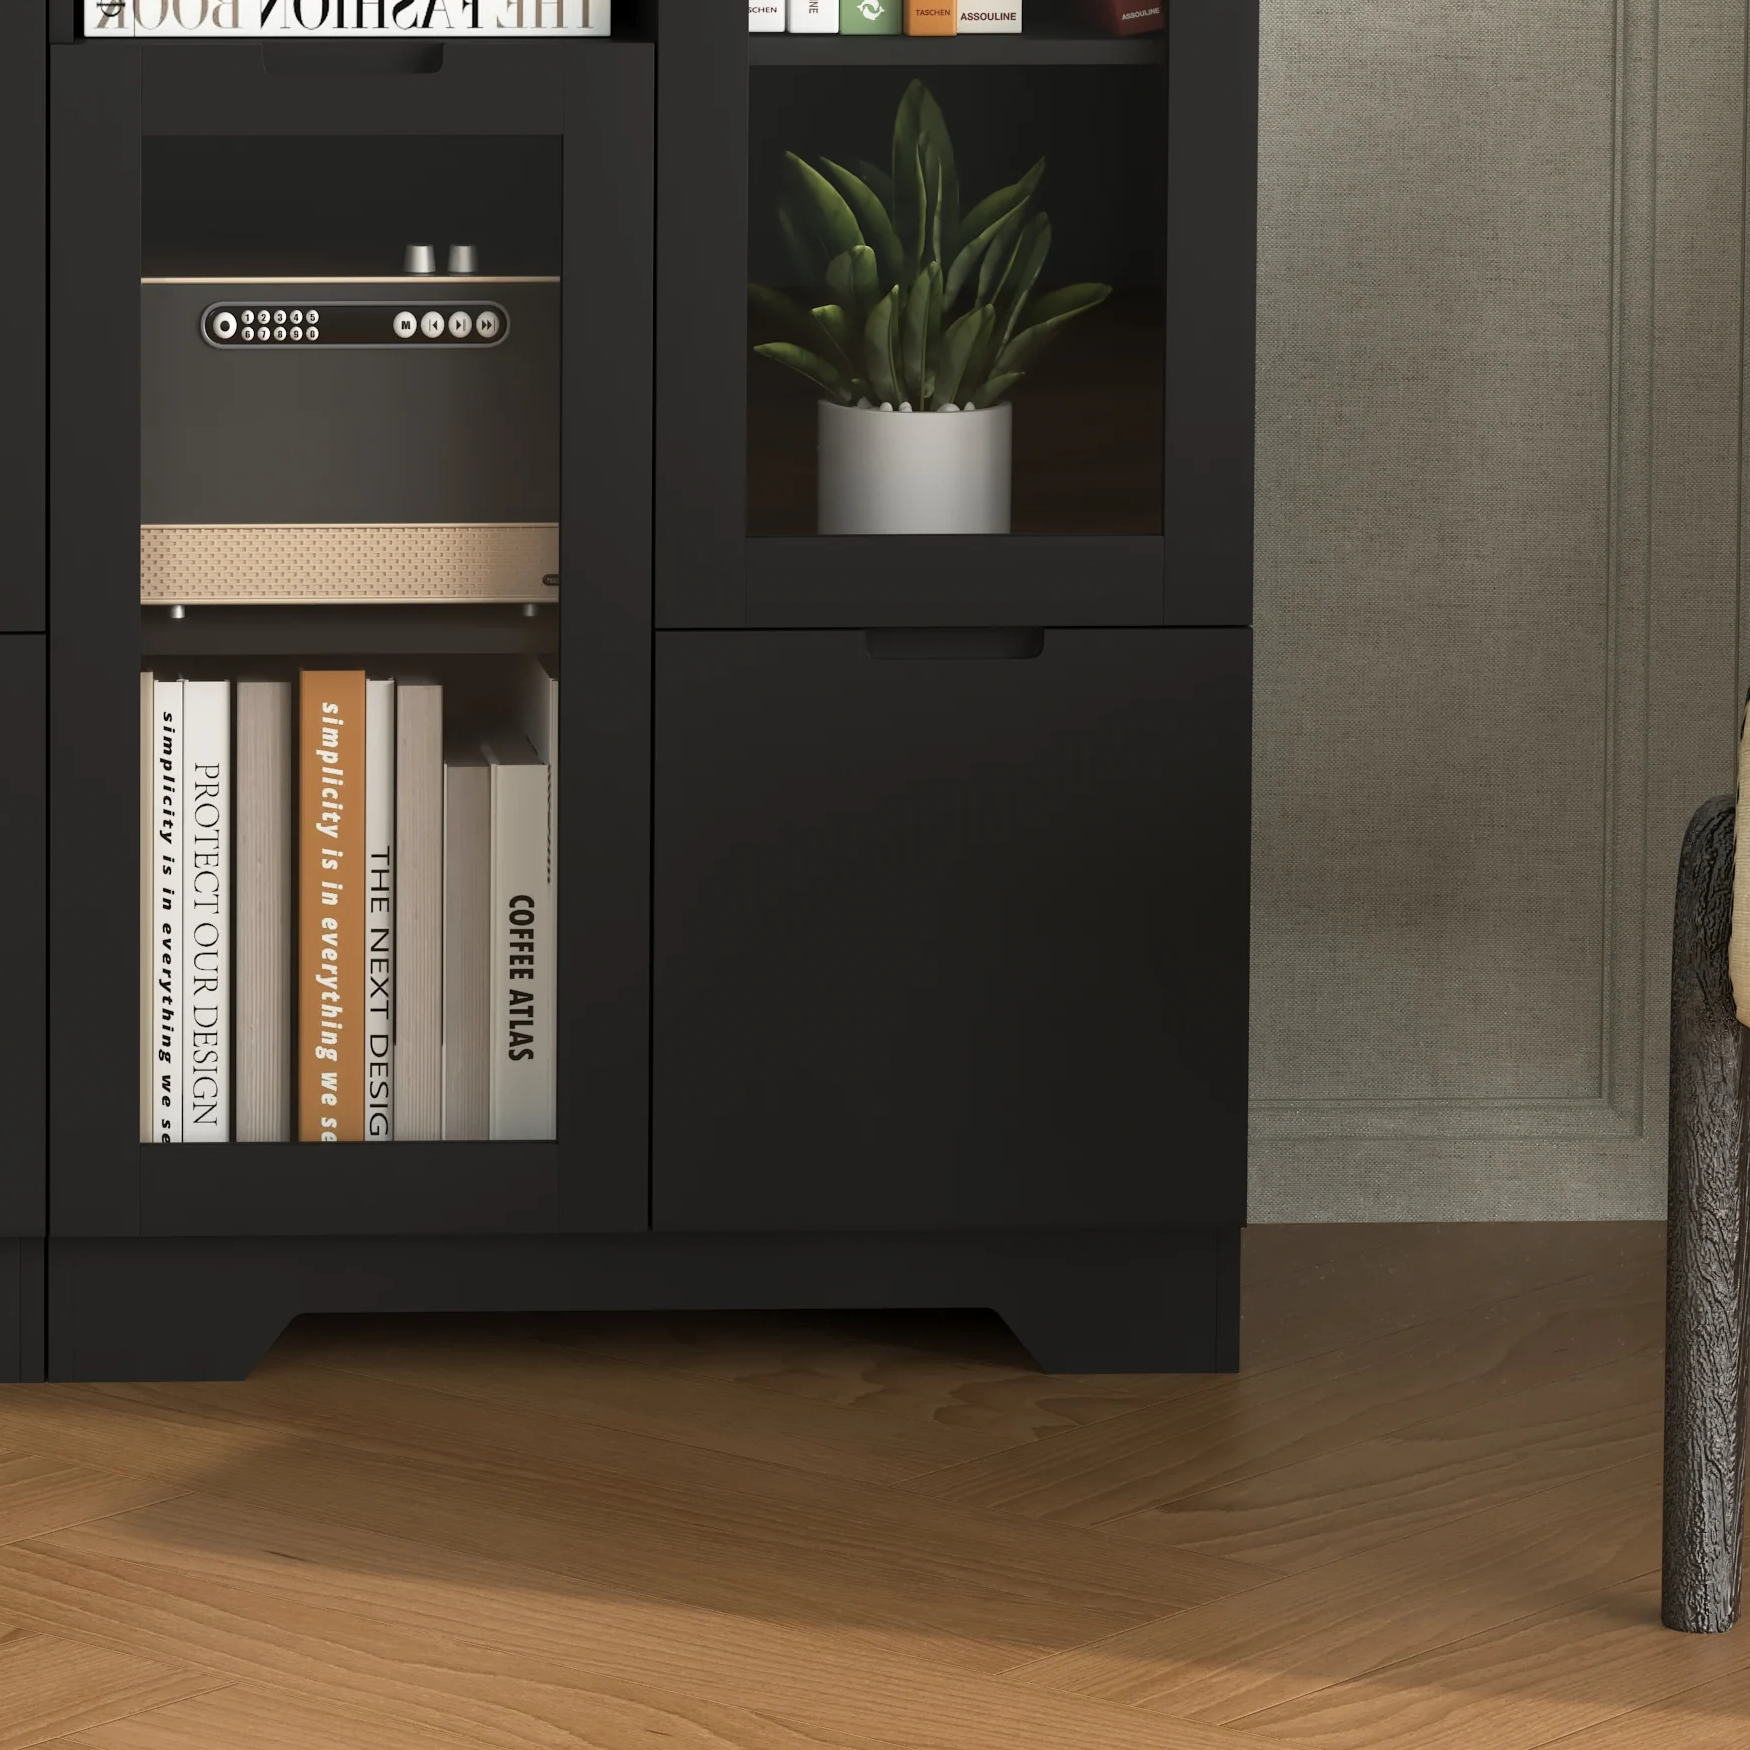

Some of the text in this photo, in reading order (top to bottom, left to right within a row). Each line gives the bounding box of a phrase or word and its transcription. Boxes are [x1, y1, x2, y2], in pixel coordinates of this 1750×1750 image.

[748, 6, 777, 14] SCHEN
[915, 8, 951, 16] TASCHEN
[960, 12, 1017, 21] ASSOULINE
[1122, 7, 1160, 20] ASSOULINE
[246, 314, 316, 322] 1 2 3 4 5
[401, 320, 411, 329] M
[245, 330, 315, 338] 6 7 8 9 0
[160, 711, 175, 844] simplicity
[315, 702, 344, 838] simplicity
[162, 854, 175, 876] is
[321, 848, 344, 871] is
[162, 887, 175, 910] in
[321, 881, 344, 906] in
[193, 762, 220, 1127] PROTECT OUR DESIGN
[315, 917, 343, 1062] everything
[508, 895, 535, 1061] COFFEE ATLAS
[159, 922, 175, 1064] everything
[369, 845, 390, 1136] THE NEXT DESIG
[161, 1074, 171, 1108] we
[321, 1072, 338, 1106] we
